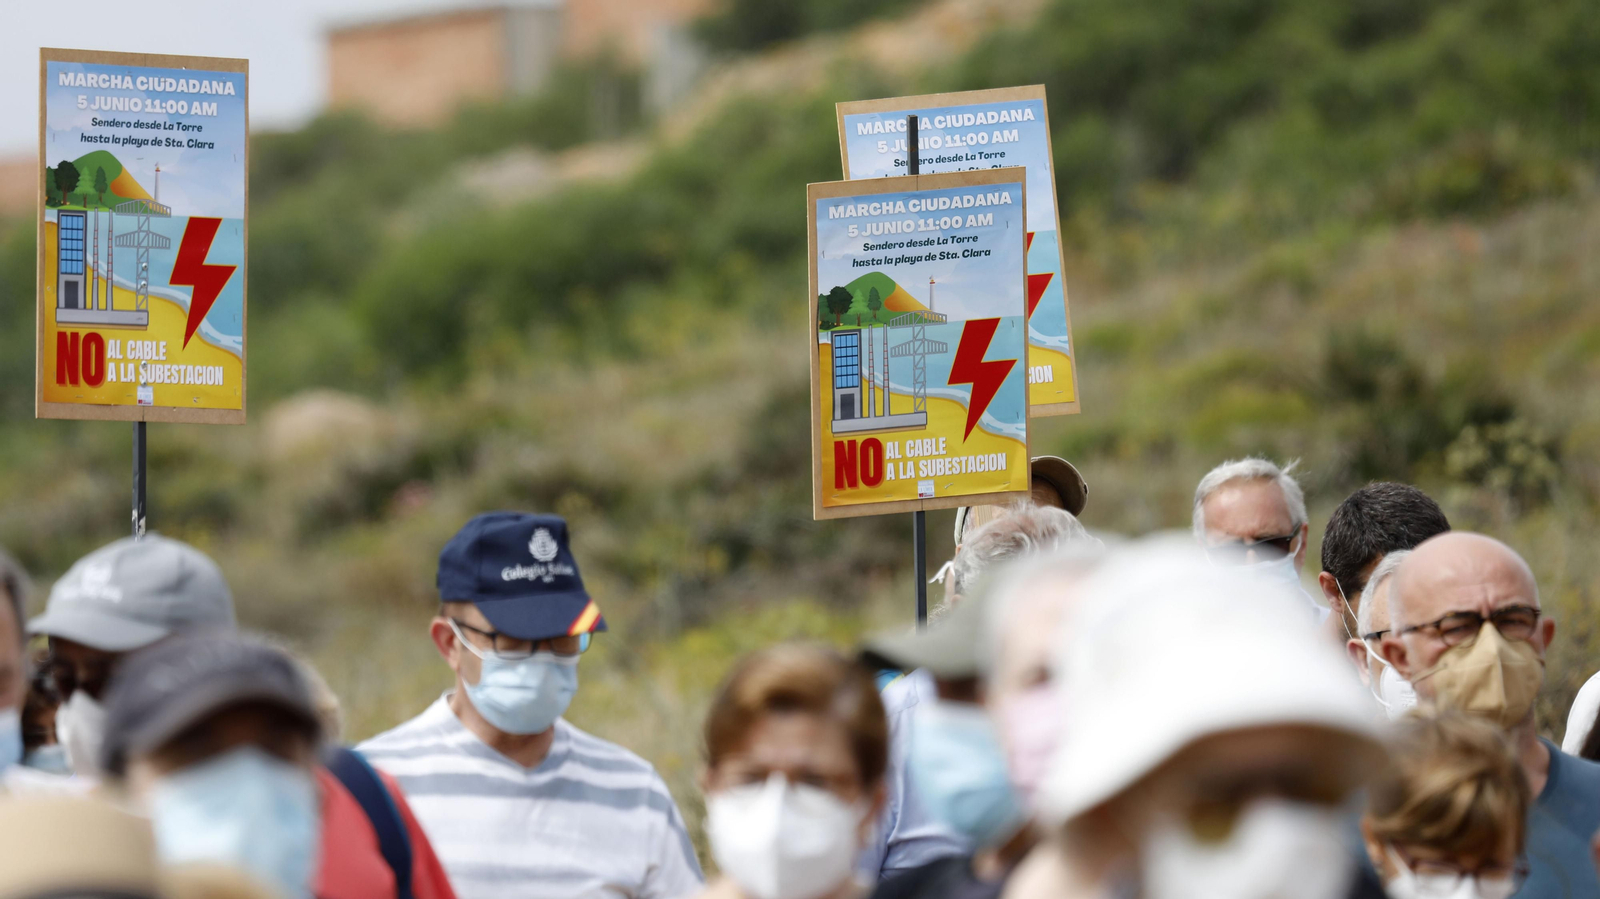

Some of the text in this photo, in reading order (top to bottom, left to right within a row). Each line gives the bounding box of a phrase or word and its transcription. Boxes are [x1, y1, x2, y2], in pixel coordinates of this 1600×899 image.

[59, 72, 236, 96] MARCHA CIUDADANA
[77, 95, 218, 116] 5 JUNIO 11:00 AM
[91, 117, 203, 132] Sendero desde La Torre
[857, 108, 1035, 136] MARCA CIUDADANA
[80, 133, 214, 149] hasta la playa de Sta. Clara
[877, 140, 888, 153] 5
[945, 132, 988, 147] 11:00
[991, 129, 1019, 144] AM
[894, 152, 1005, 167] Seero desde La Torre
[828, 192, 1012, 219] MARCHA CIUDADANA
[848, 213, 993, 238] 5 JUNIO 11:00 AM
[863, 235, 978, 252] Sendero desde La Torre
[852, 249, 991, 267] hasta la playa de Sta. Clara
[56, 331, 105, 388] NO
[107, 340, 167, 360] AL CABLE
[107, 363, 224, 385] A LA SUBESTACION
[886, 437, 946, 459] AL CABLE
[834, 437, 884, 490] NO
[886, 453, 1006, 481] A LA SUBESTACION
